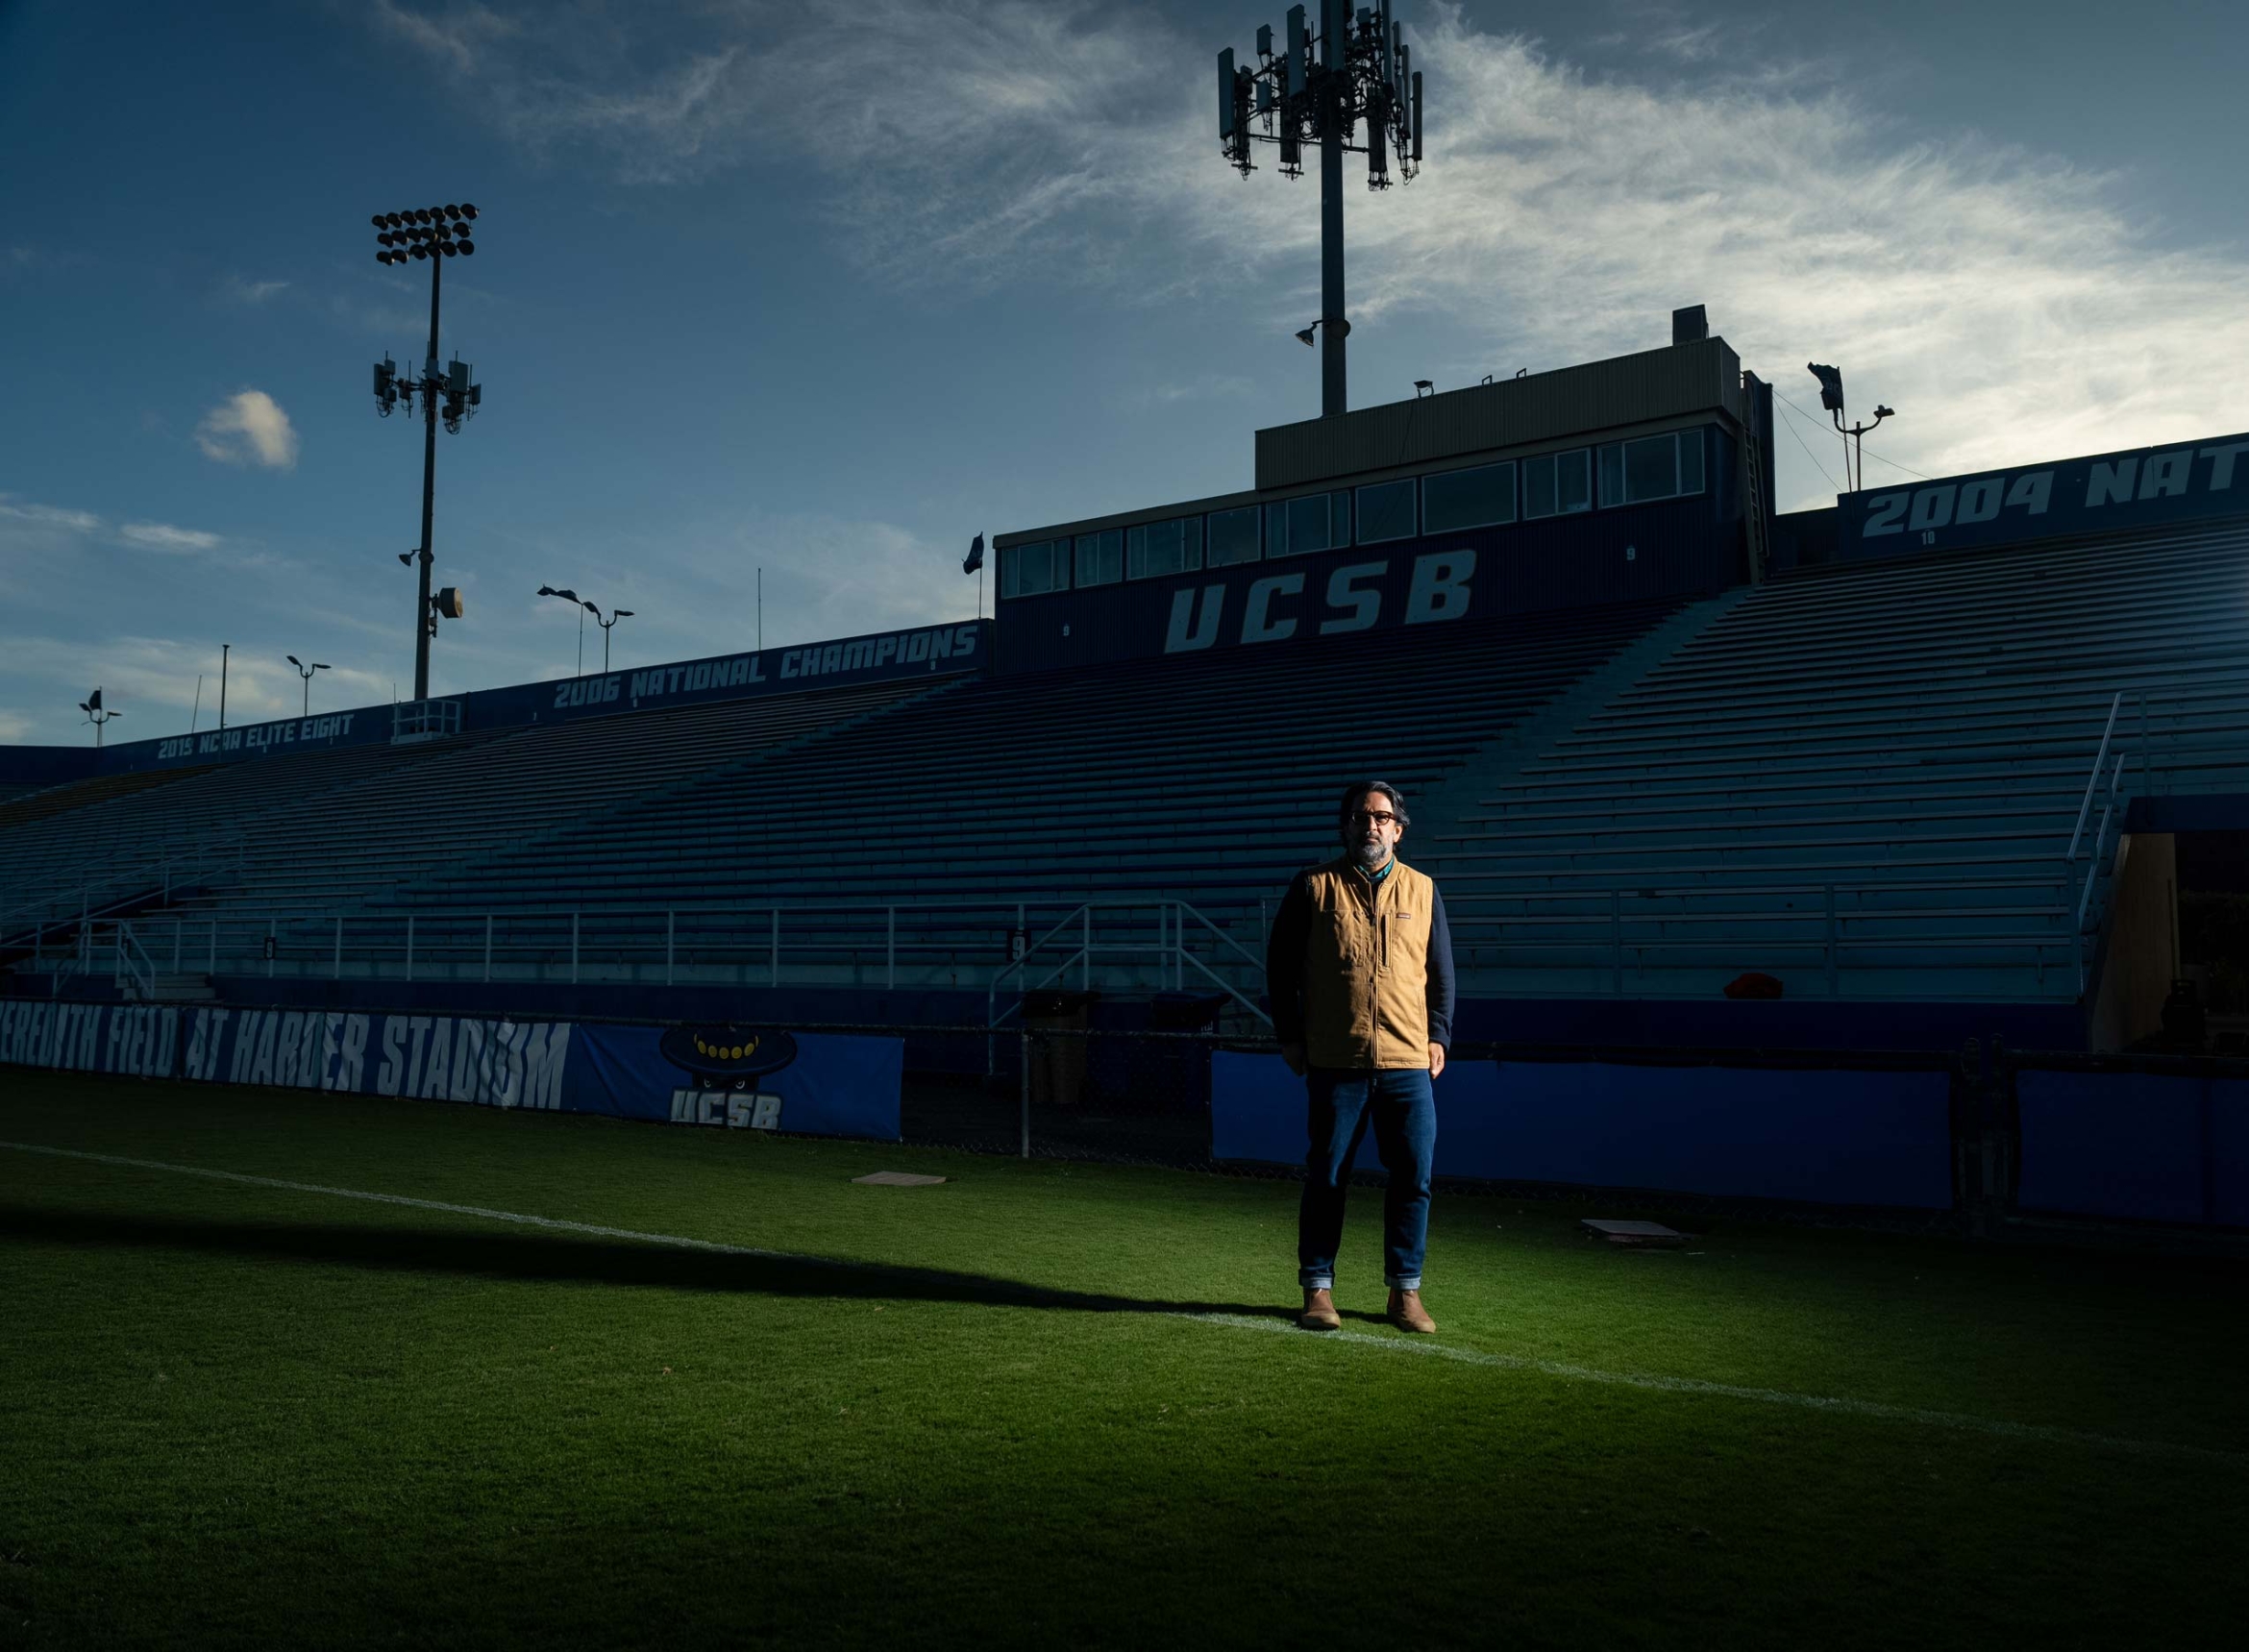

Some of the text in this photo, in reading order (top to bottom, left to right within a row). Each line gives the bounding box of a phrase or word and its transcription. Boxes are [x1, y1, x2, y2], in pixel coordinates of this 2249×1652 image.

[1862, 442, 2249, 538] 2004 NAT
[1625, 547, 1636, 560] 9
[1920, 530, 1935, 546] 10
[1163, 549, 1478, 654] UCSB
[554, 625, 978, 708] 2006 NATIONAL CHAMPIONS
[157, 714, 355, 759] 2015 NCAA ELITE EIGHT
[1012, 936, 1025, 960] 9
[106, 1005, 180, 1078] FIELD
[184, 1007, 230, 1082] AT
[230, 1010, 371, 1094] HARDER
[378, 1014, 572, 1111] STADIUM
[671, 1089, 782, 1130] UCSB
